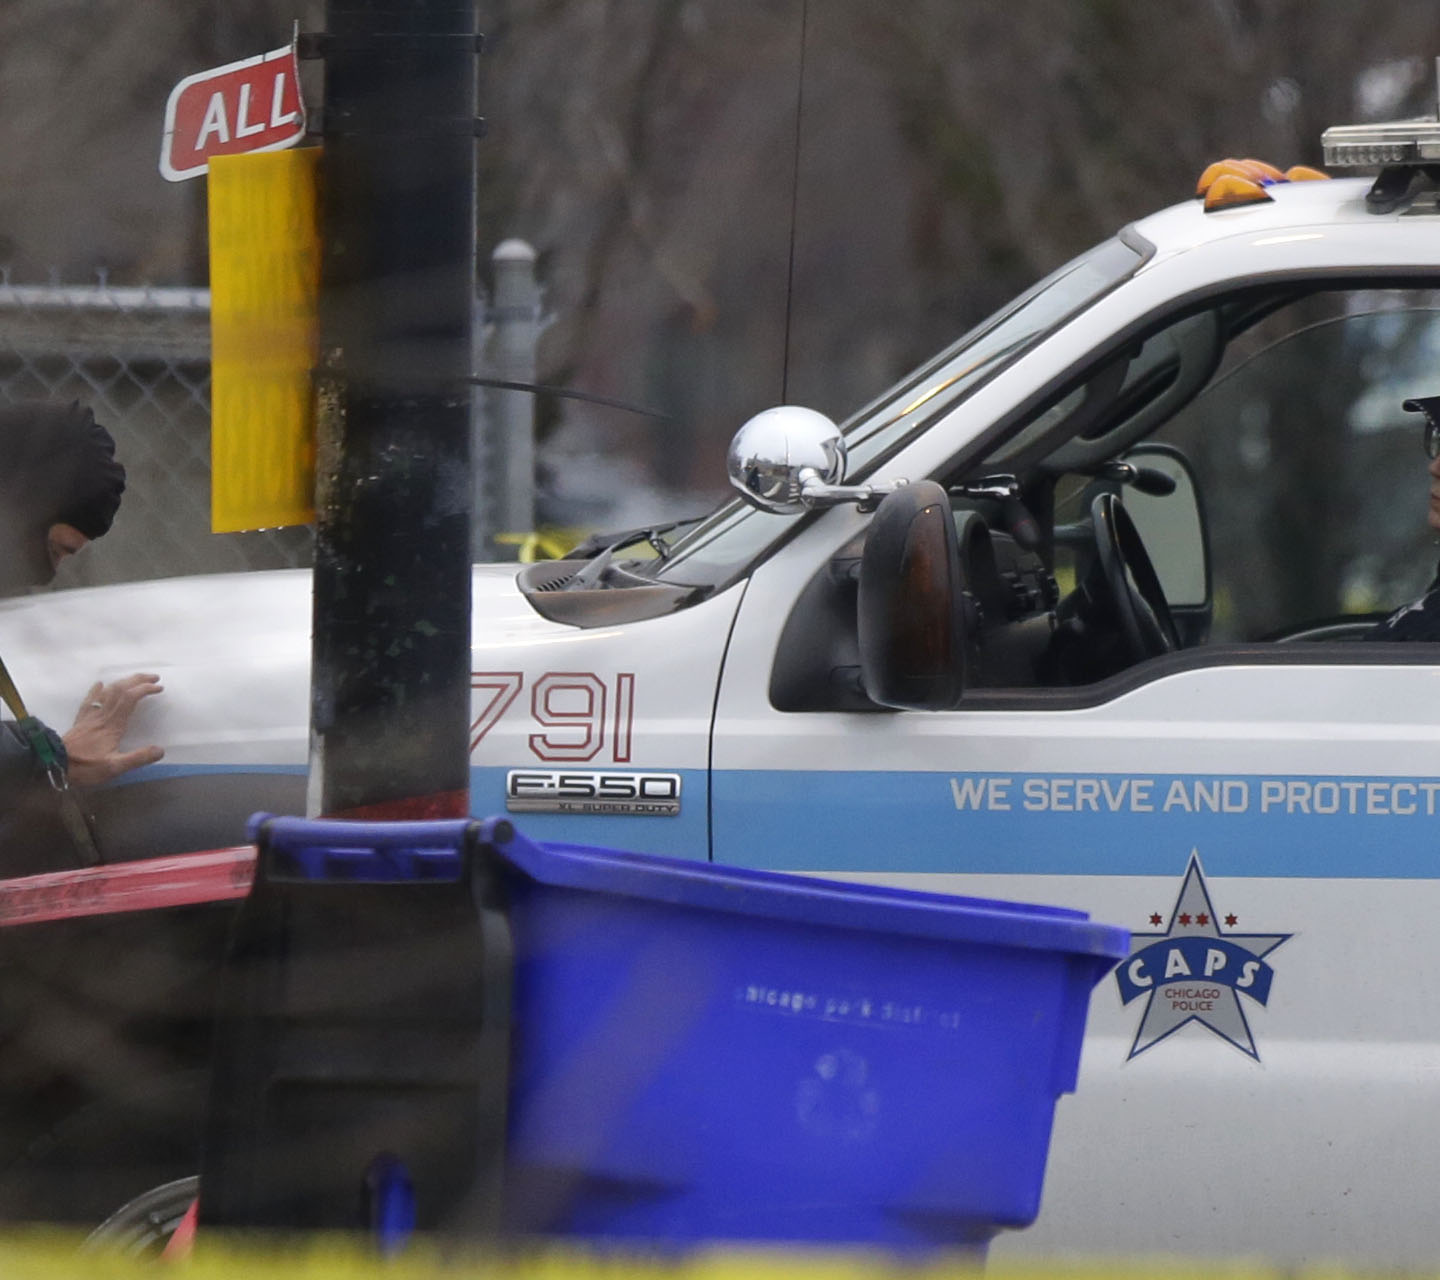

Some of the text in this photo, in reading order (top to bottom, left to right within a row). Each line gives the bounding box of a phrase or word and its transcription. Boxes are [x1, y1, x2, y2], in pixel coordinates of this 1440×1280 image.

[194, 72, 300, 151] ALL
[470, 672, 635, 763] 791
[635, 803, 675, 813] DUTY
[950, 777, 1012, 811] WE
[1023, 778, 1154, 813] SERVE
[1162, 780, 1249, 814] AND
[1127, 948, 1261, 988] CAPS
[1164, 988, 1221, 1000] CHICAGO
[1172, 1000, 1214, 1012] POLICE
